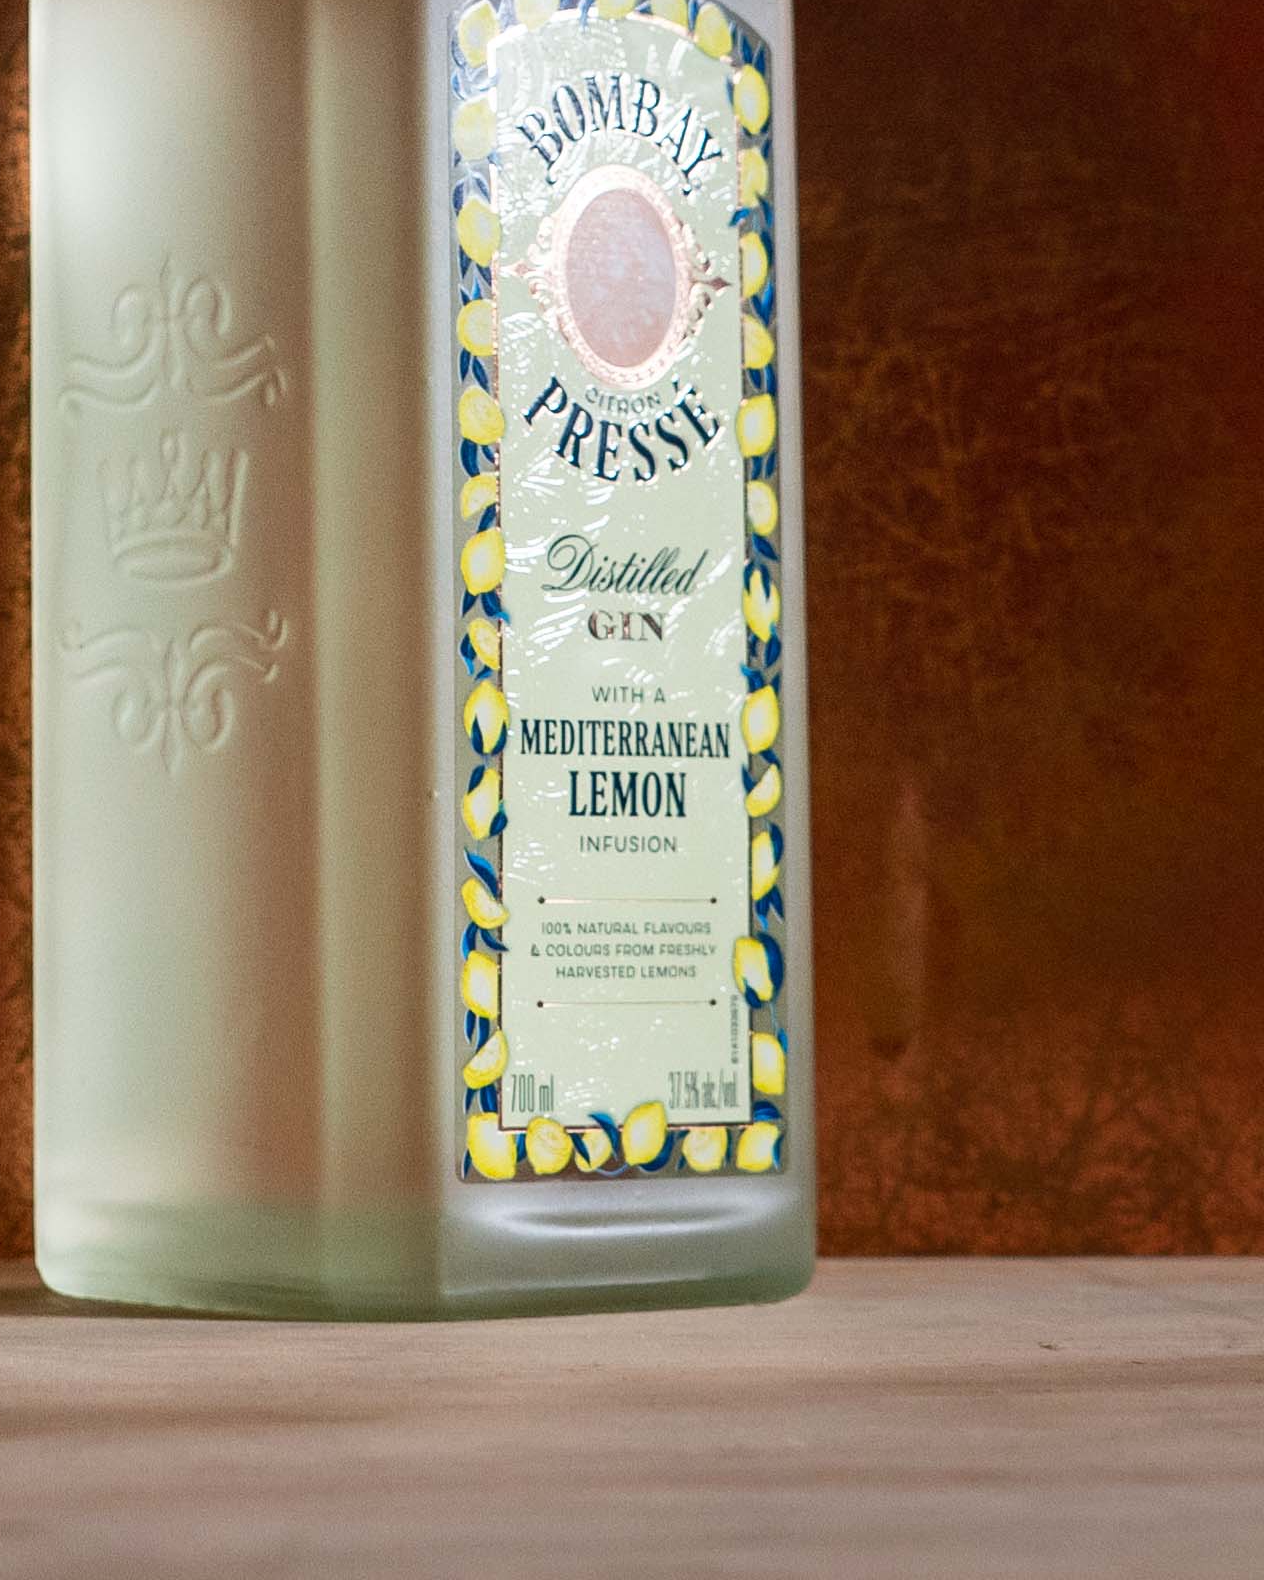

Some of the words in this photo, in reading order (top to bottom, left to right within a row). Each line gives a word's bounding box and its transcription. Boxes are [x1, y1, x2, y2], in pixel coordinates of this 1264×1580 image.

[516, 73, 724, 196] BOMBAY
[585, 387, 662, 414] CITRON
[524, 376, 722, 483] PRESSÉ
[542, 534, 709, 596] Distilled
[588, 610, 665, 641] GIN
[592, 686, 644, 704] WITH
[653, 686, 667, 704] A
[520, 719, 731, 758] MEDITERRANEAN
[568, 771, 688, 818] LEMON
[579, 835, 678, 853] INFUSION
[541, 922, 572, 935] 100%
[577, 922, 638, 935] NATURAL
[644, 922, 712, 935] FLAVOURS
[530, 944, 541, 957] &
[545, 944, 611, 957] COLOURS
[615, 944, 655, 957] FROM
[659, 943, 717, 956] FRESHLY
[556, 966, 636, 979] HARVESTED
[640, 966, 697, 979] LEMONS
[511, 1074, 535, 1112] 700
[539, 1073, 555, 1112] ml
[668, 1071, 700, 1110] 37.5%
